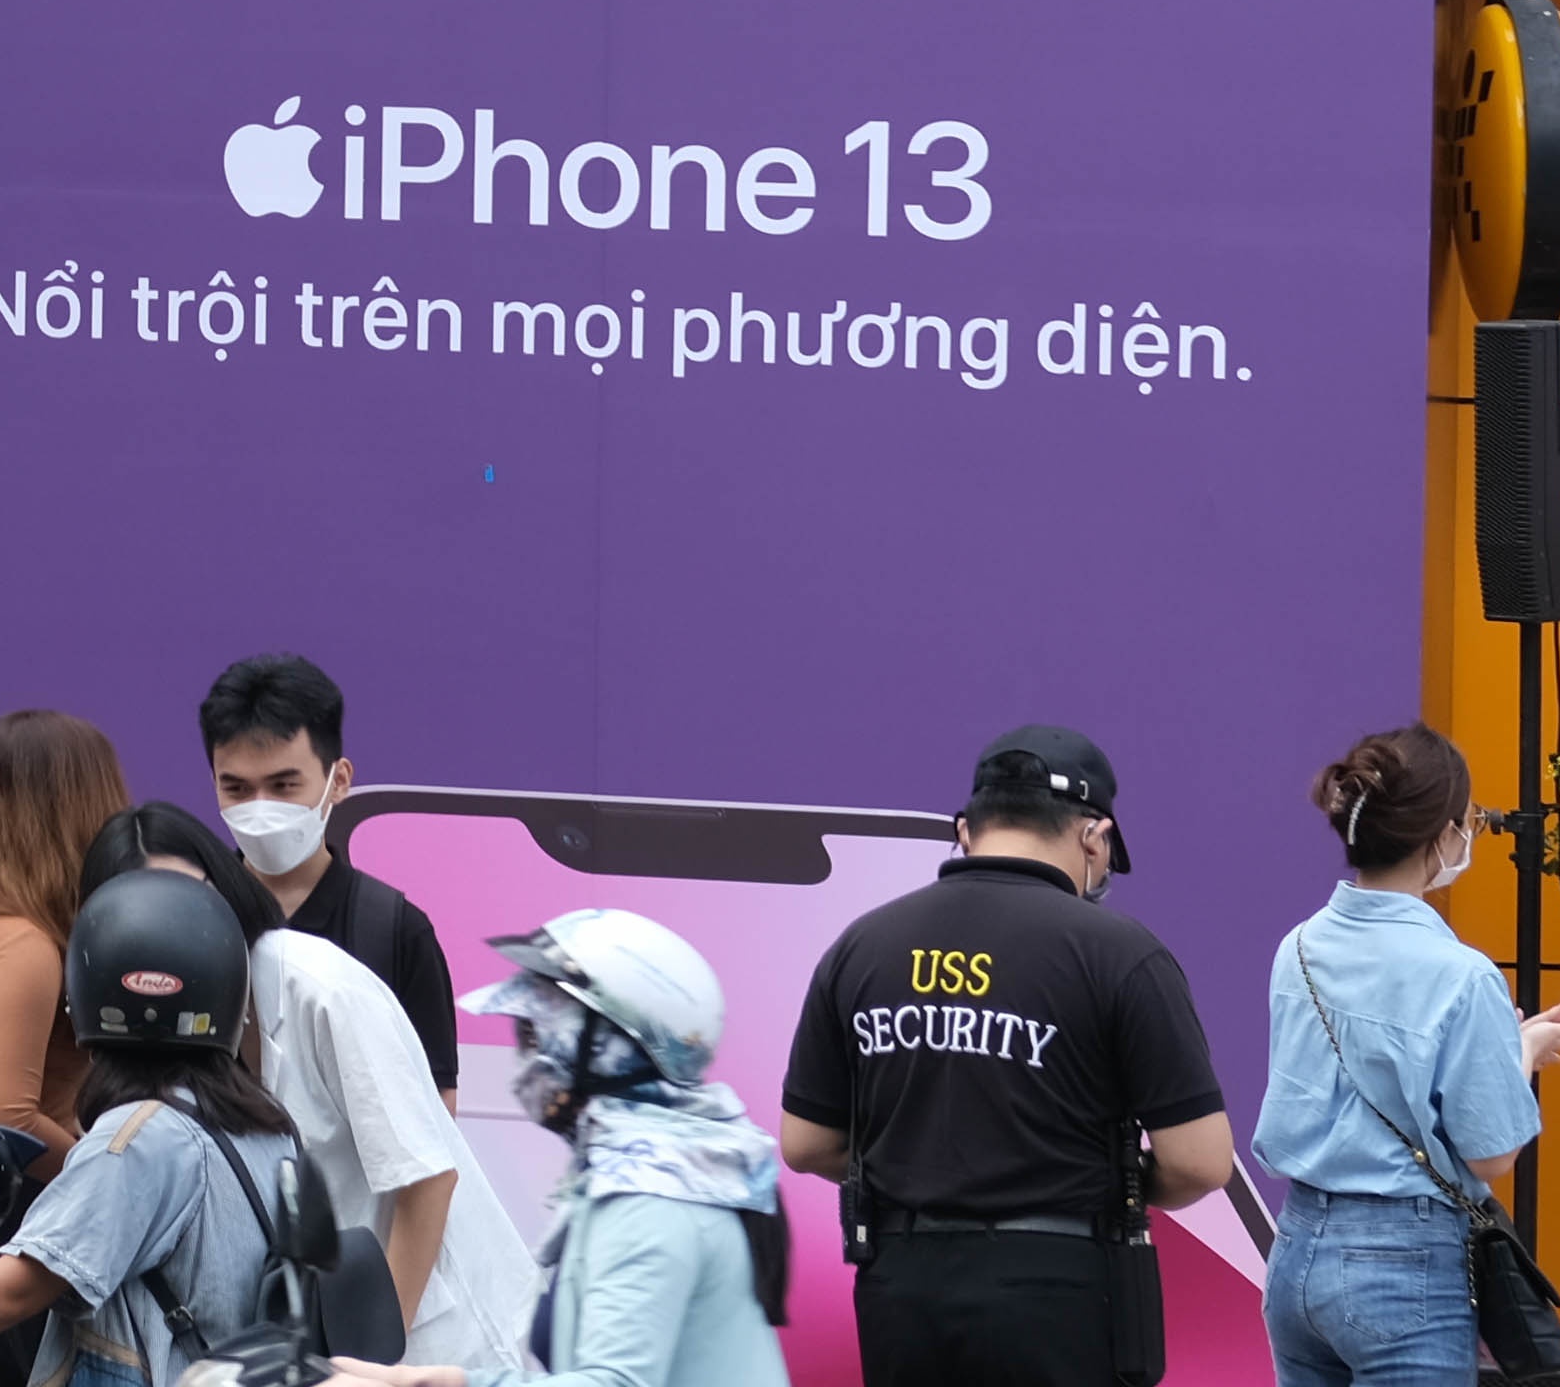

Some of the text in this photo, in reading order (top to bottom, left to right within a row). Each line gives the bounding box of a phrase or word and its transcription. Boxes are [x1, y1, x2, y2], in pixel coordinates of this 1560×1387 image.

[344, 103, 993, 243] iPhone 13
[131, 270, 269, 362] trội
[295, 277, 463, 353] trên
[490, 290, 647, 376] mọi
[672, 299, 1011, 390] phương
[1037, 300, 1253, 396] diện.
[909, 949, 993, 998] USS
[851, 1004, 1059, 1069] SECURITY
